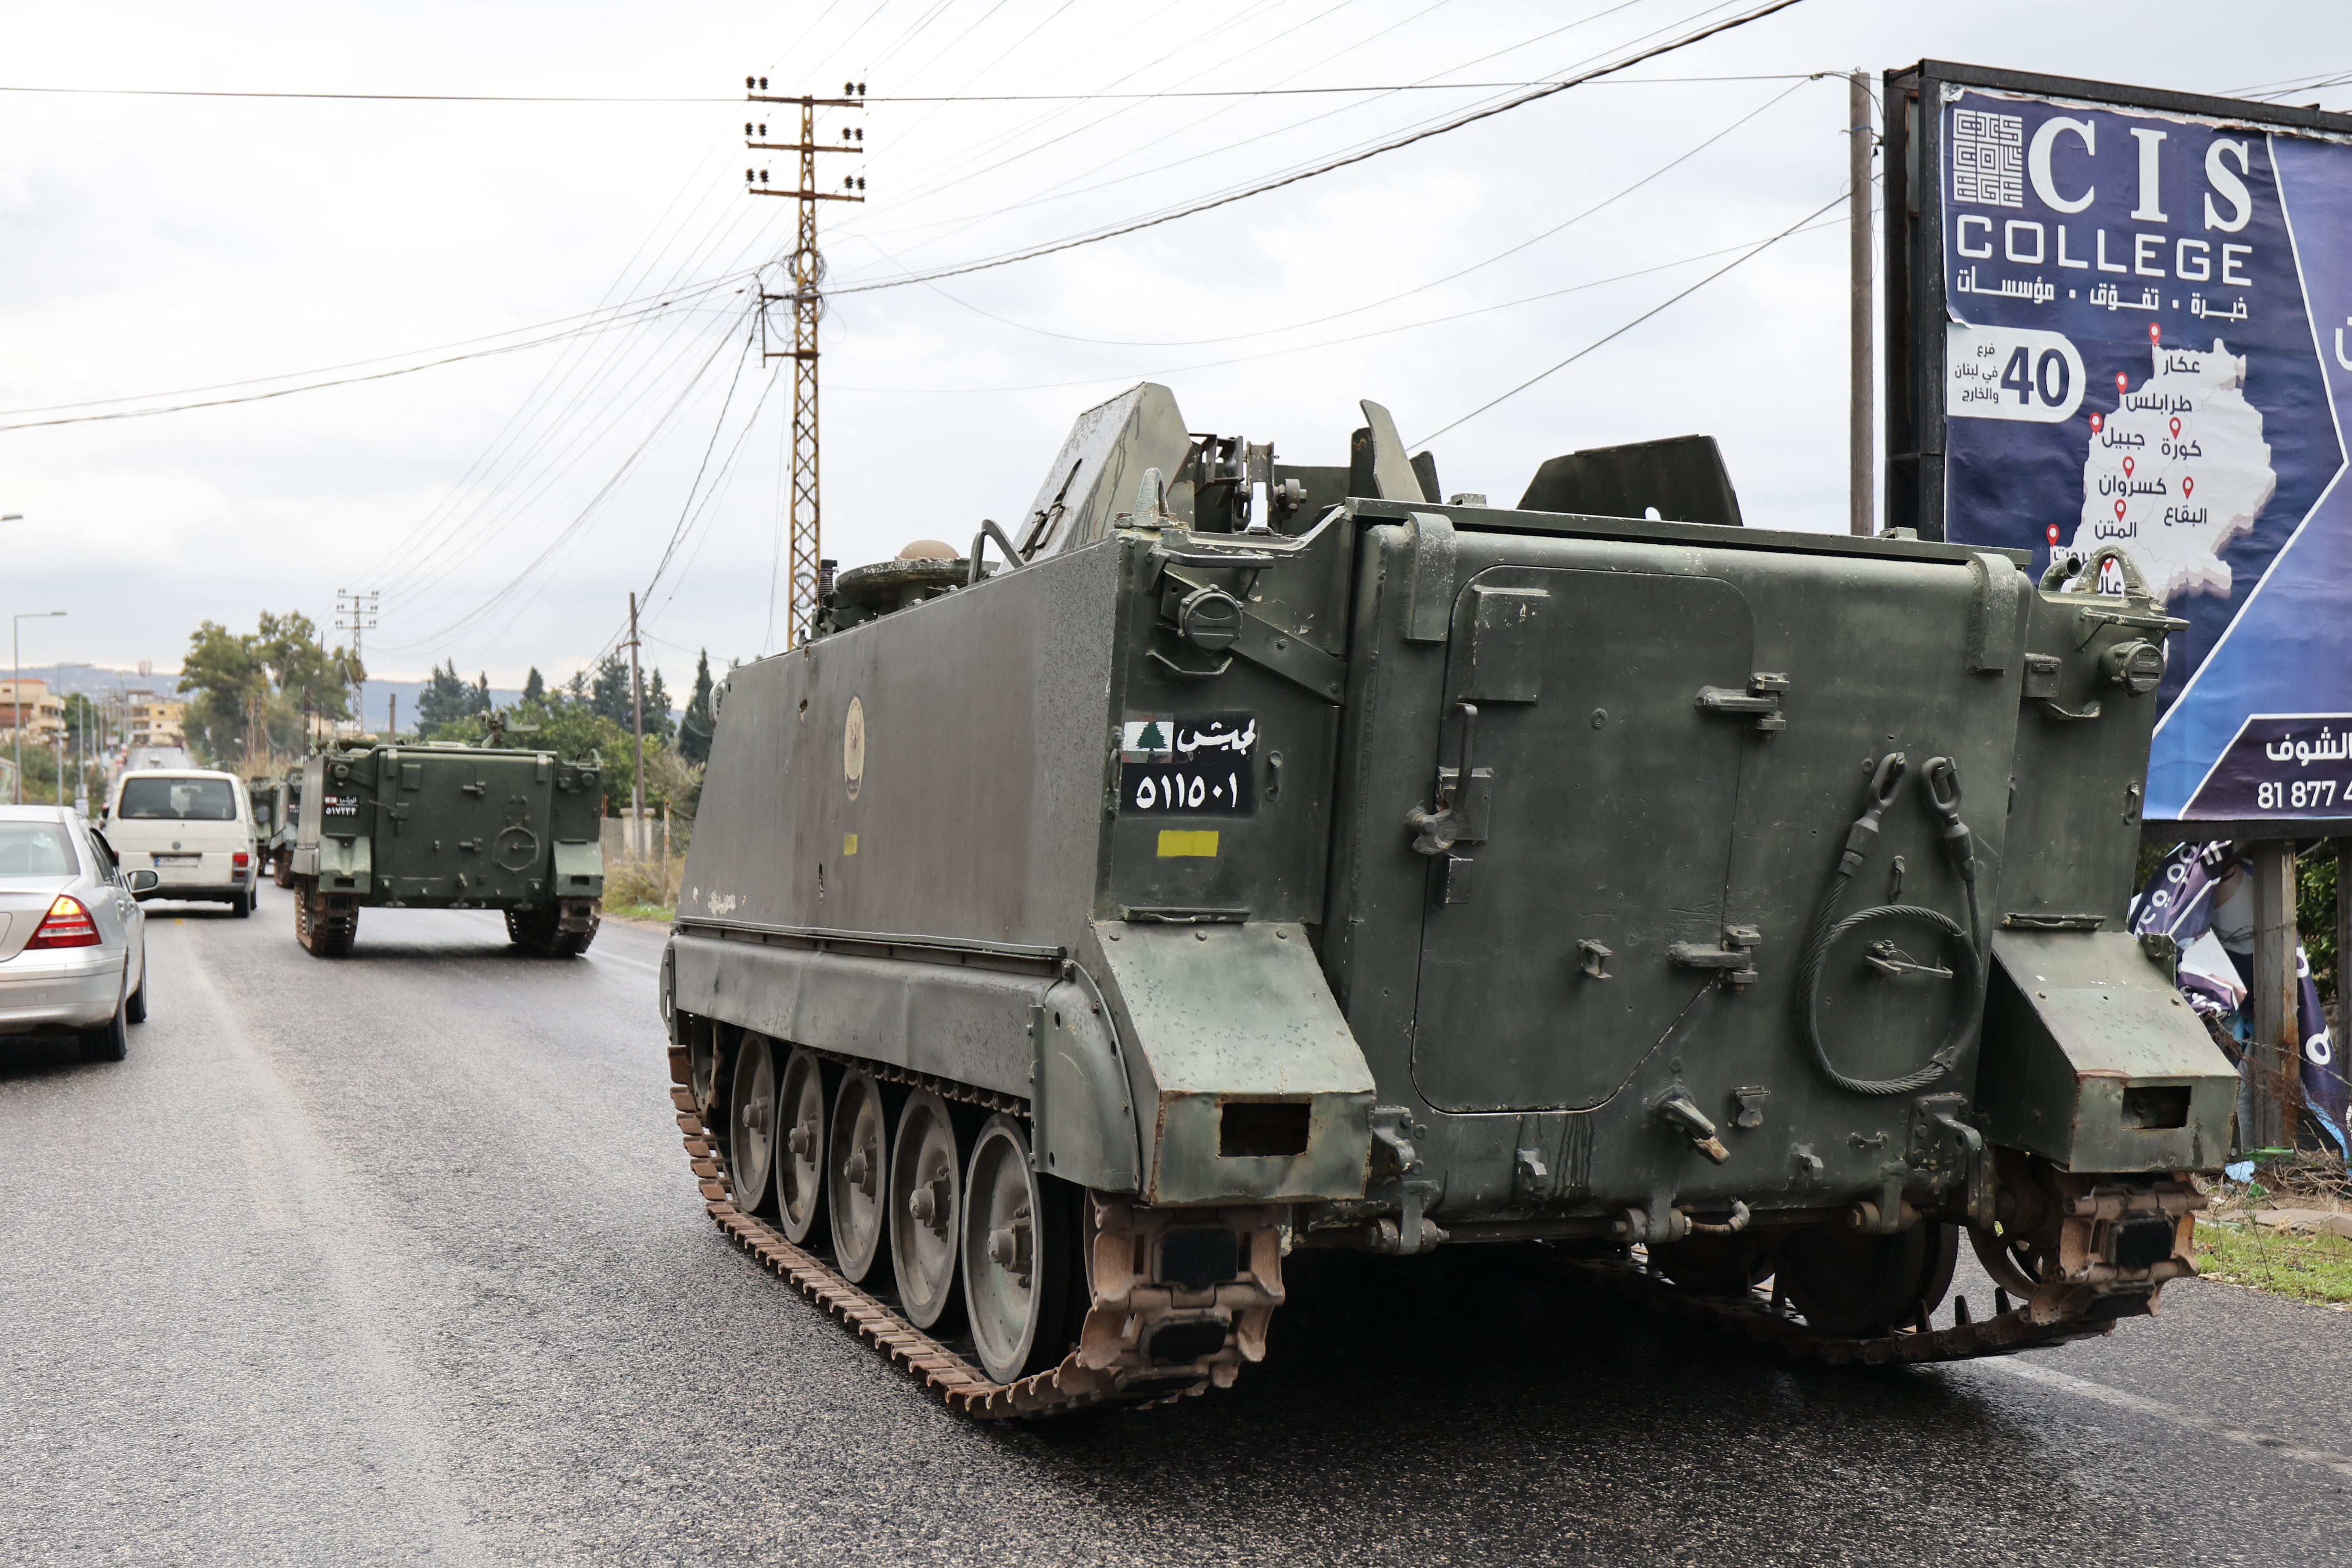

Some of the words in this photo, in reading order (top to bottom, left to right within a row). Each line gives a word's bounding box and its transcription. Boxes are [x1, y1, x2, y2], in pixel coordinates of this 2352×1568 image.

[2027, 116, 2252, 232] CIS
[1956, 215, 2252, 286] COLLEGE
[1957, 265, 2055, 304] مؤسسات
[2191, 292, 2248, 323] خبرة
[1977, 343, 1995, 358] فرع
[1955, 363, 1979, 379] لبنان
[1982, 366, 1998, 384] في
[2000, 346, 2069, 407] 40
[2163, 355, 2201, 375] عكار
[1962, 386, 1999, 404] والخارج
[2125, 392, 2193, 415] طرابلس
[2101, 426, 2145, 450] جبيل
[2161, 438, 2202, 461] كورة
[2098, 474, 2167, 497] كسروان
[2163, 505, 2208, 527] البقاع
[2095, 520, 2137, 540] المتن
[1136, 772, 1238, 809] ٥١١٥٠١
[2257, 782, 2283, 809] 81
[2291, 780, 2336, 808] 877
